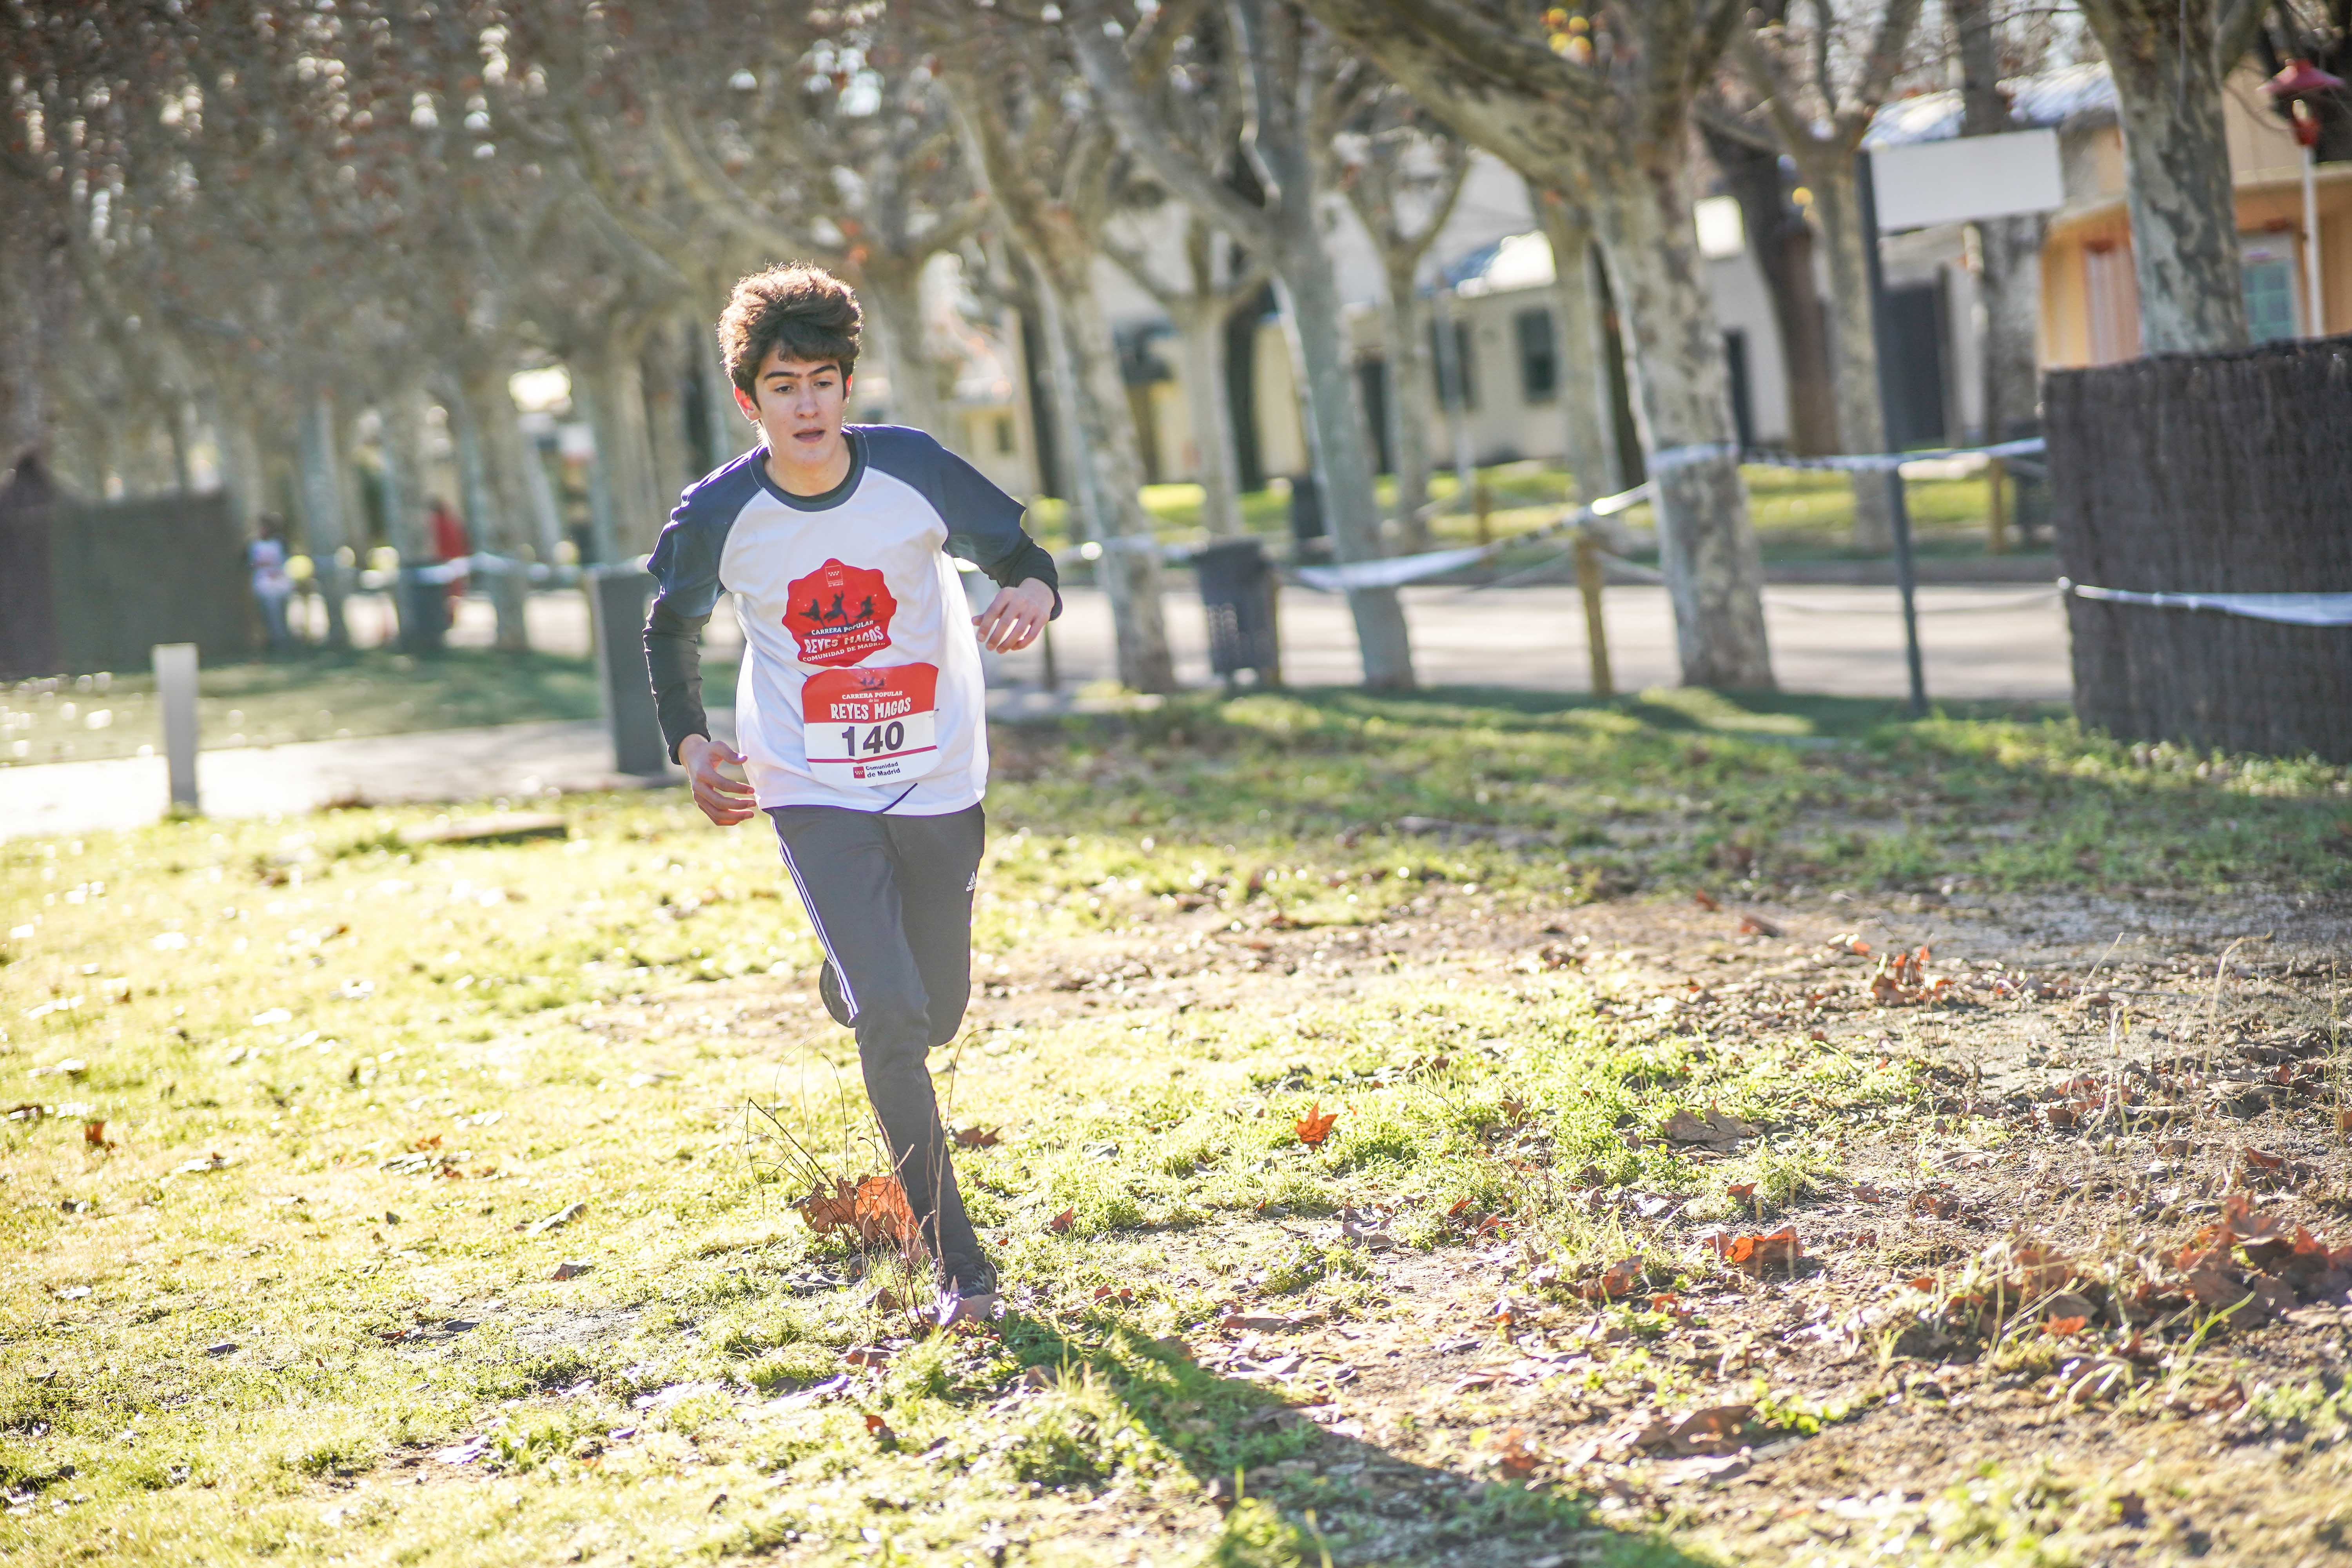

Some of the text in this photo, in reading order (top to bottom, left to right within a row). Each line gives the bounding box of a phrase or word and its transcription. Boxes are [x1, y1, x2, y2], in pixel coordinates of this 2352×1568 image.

[843, 620, 874, 633] POPULAR
[804, 638, 838, 654] REYES
[803, 649, 845, 662] COMUNIDAD
[830, 697, 911, 720] REYES MAGOS
[842, 721, 904, 757] 140
[866, 762, 898, 770] Comunidad
[877, 768, 900, 776] Madrid
